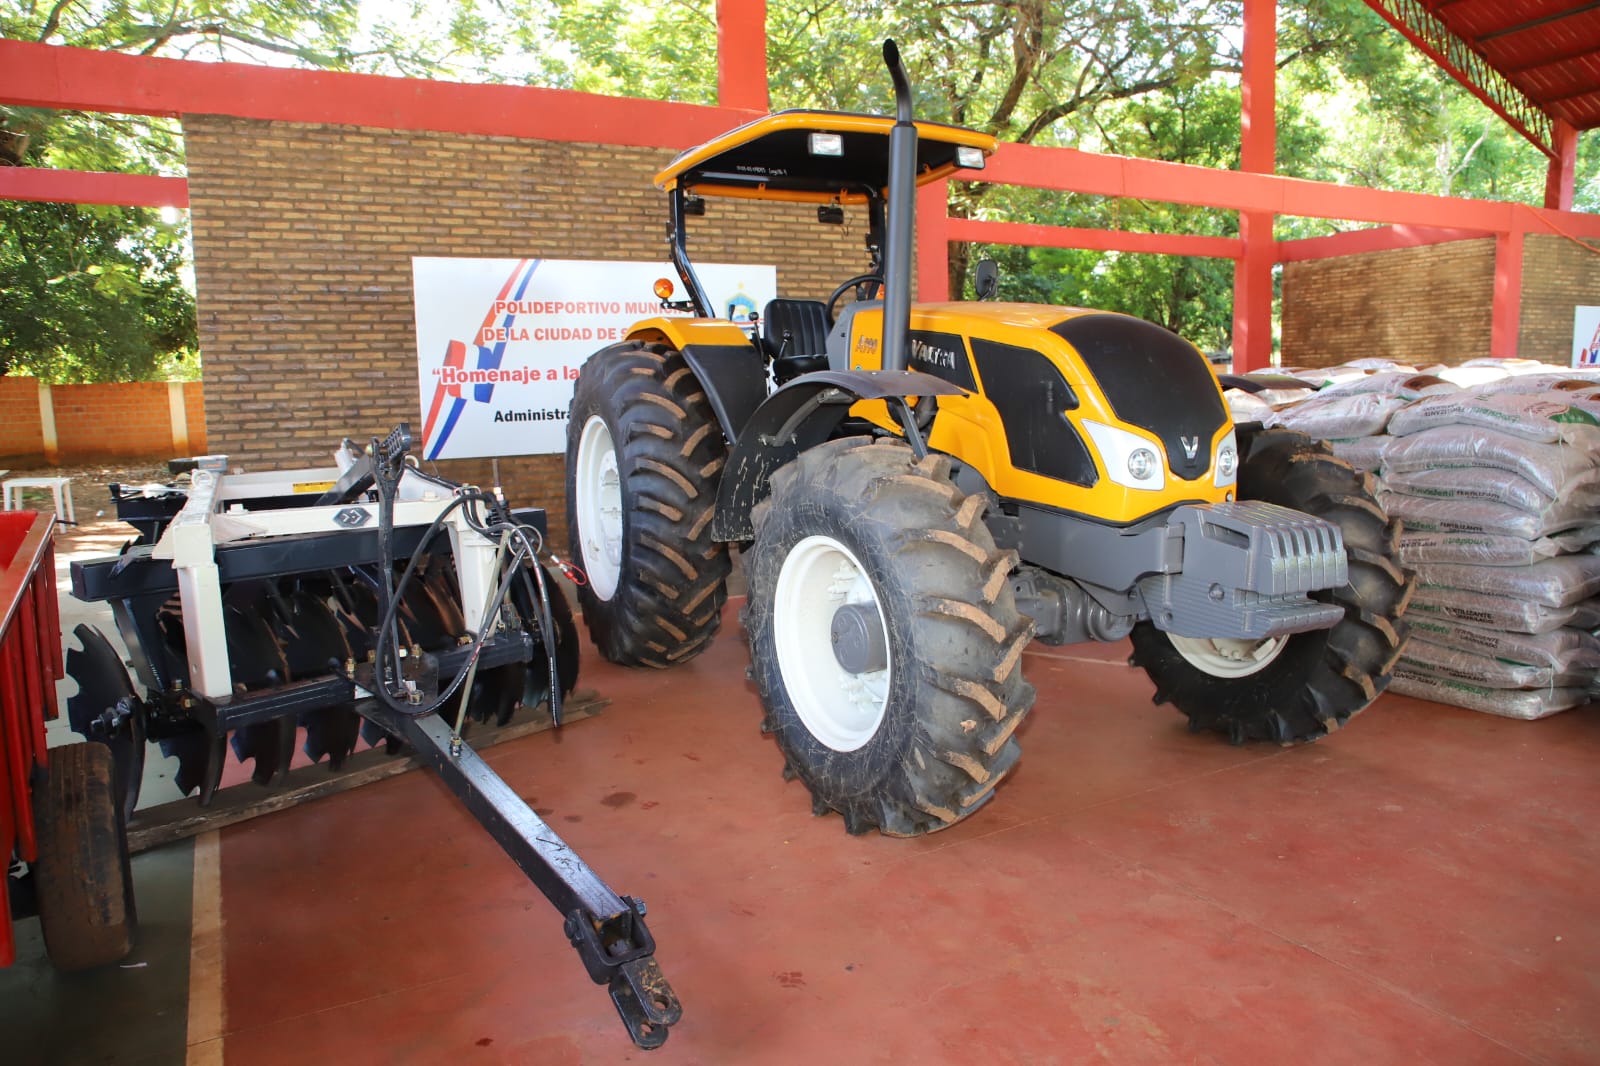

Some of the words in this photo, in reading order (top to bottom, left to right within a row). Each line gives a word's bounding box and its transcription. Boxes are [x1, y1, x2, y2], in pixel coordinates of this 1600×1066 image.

[495, 300, 621, 315] POLIDEPORTIVO
[483, 327, 506, 342] DE
[510, 328, 530, 341] LA
[534, 327, 595, 341] CIUDAD
[597, 327, 617, 340] DE
[546, 370, 558, 381] a
